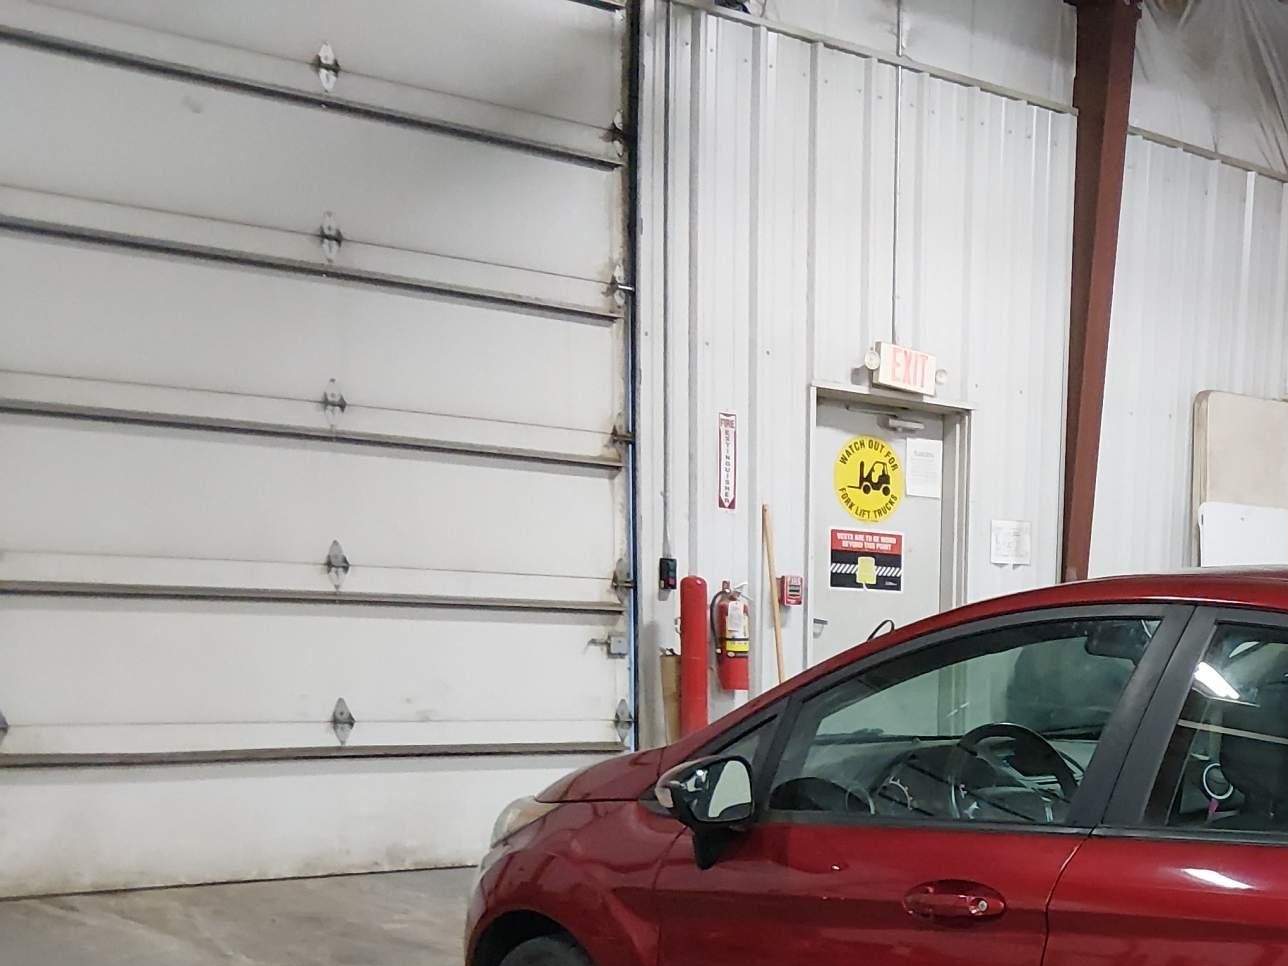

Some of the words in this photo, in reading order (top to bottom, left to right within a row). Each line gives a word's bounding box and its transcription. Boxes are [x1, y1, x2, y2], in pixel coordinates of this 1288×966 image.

[891, 346, 929, 388] EXIT
[720, 418, 735, 429] FIRE
[840, 440, 866, 465] WATCH
[868, 440, 885, 454] OUT
[884, 450, 899, 472] FOR
[838, 487, 856, 511] FORK
[855, 505, 871, 519] LIFT
[873, 494, 898, 519] TRUCKS
